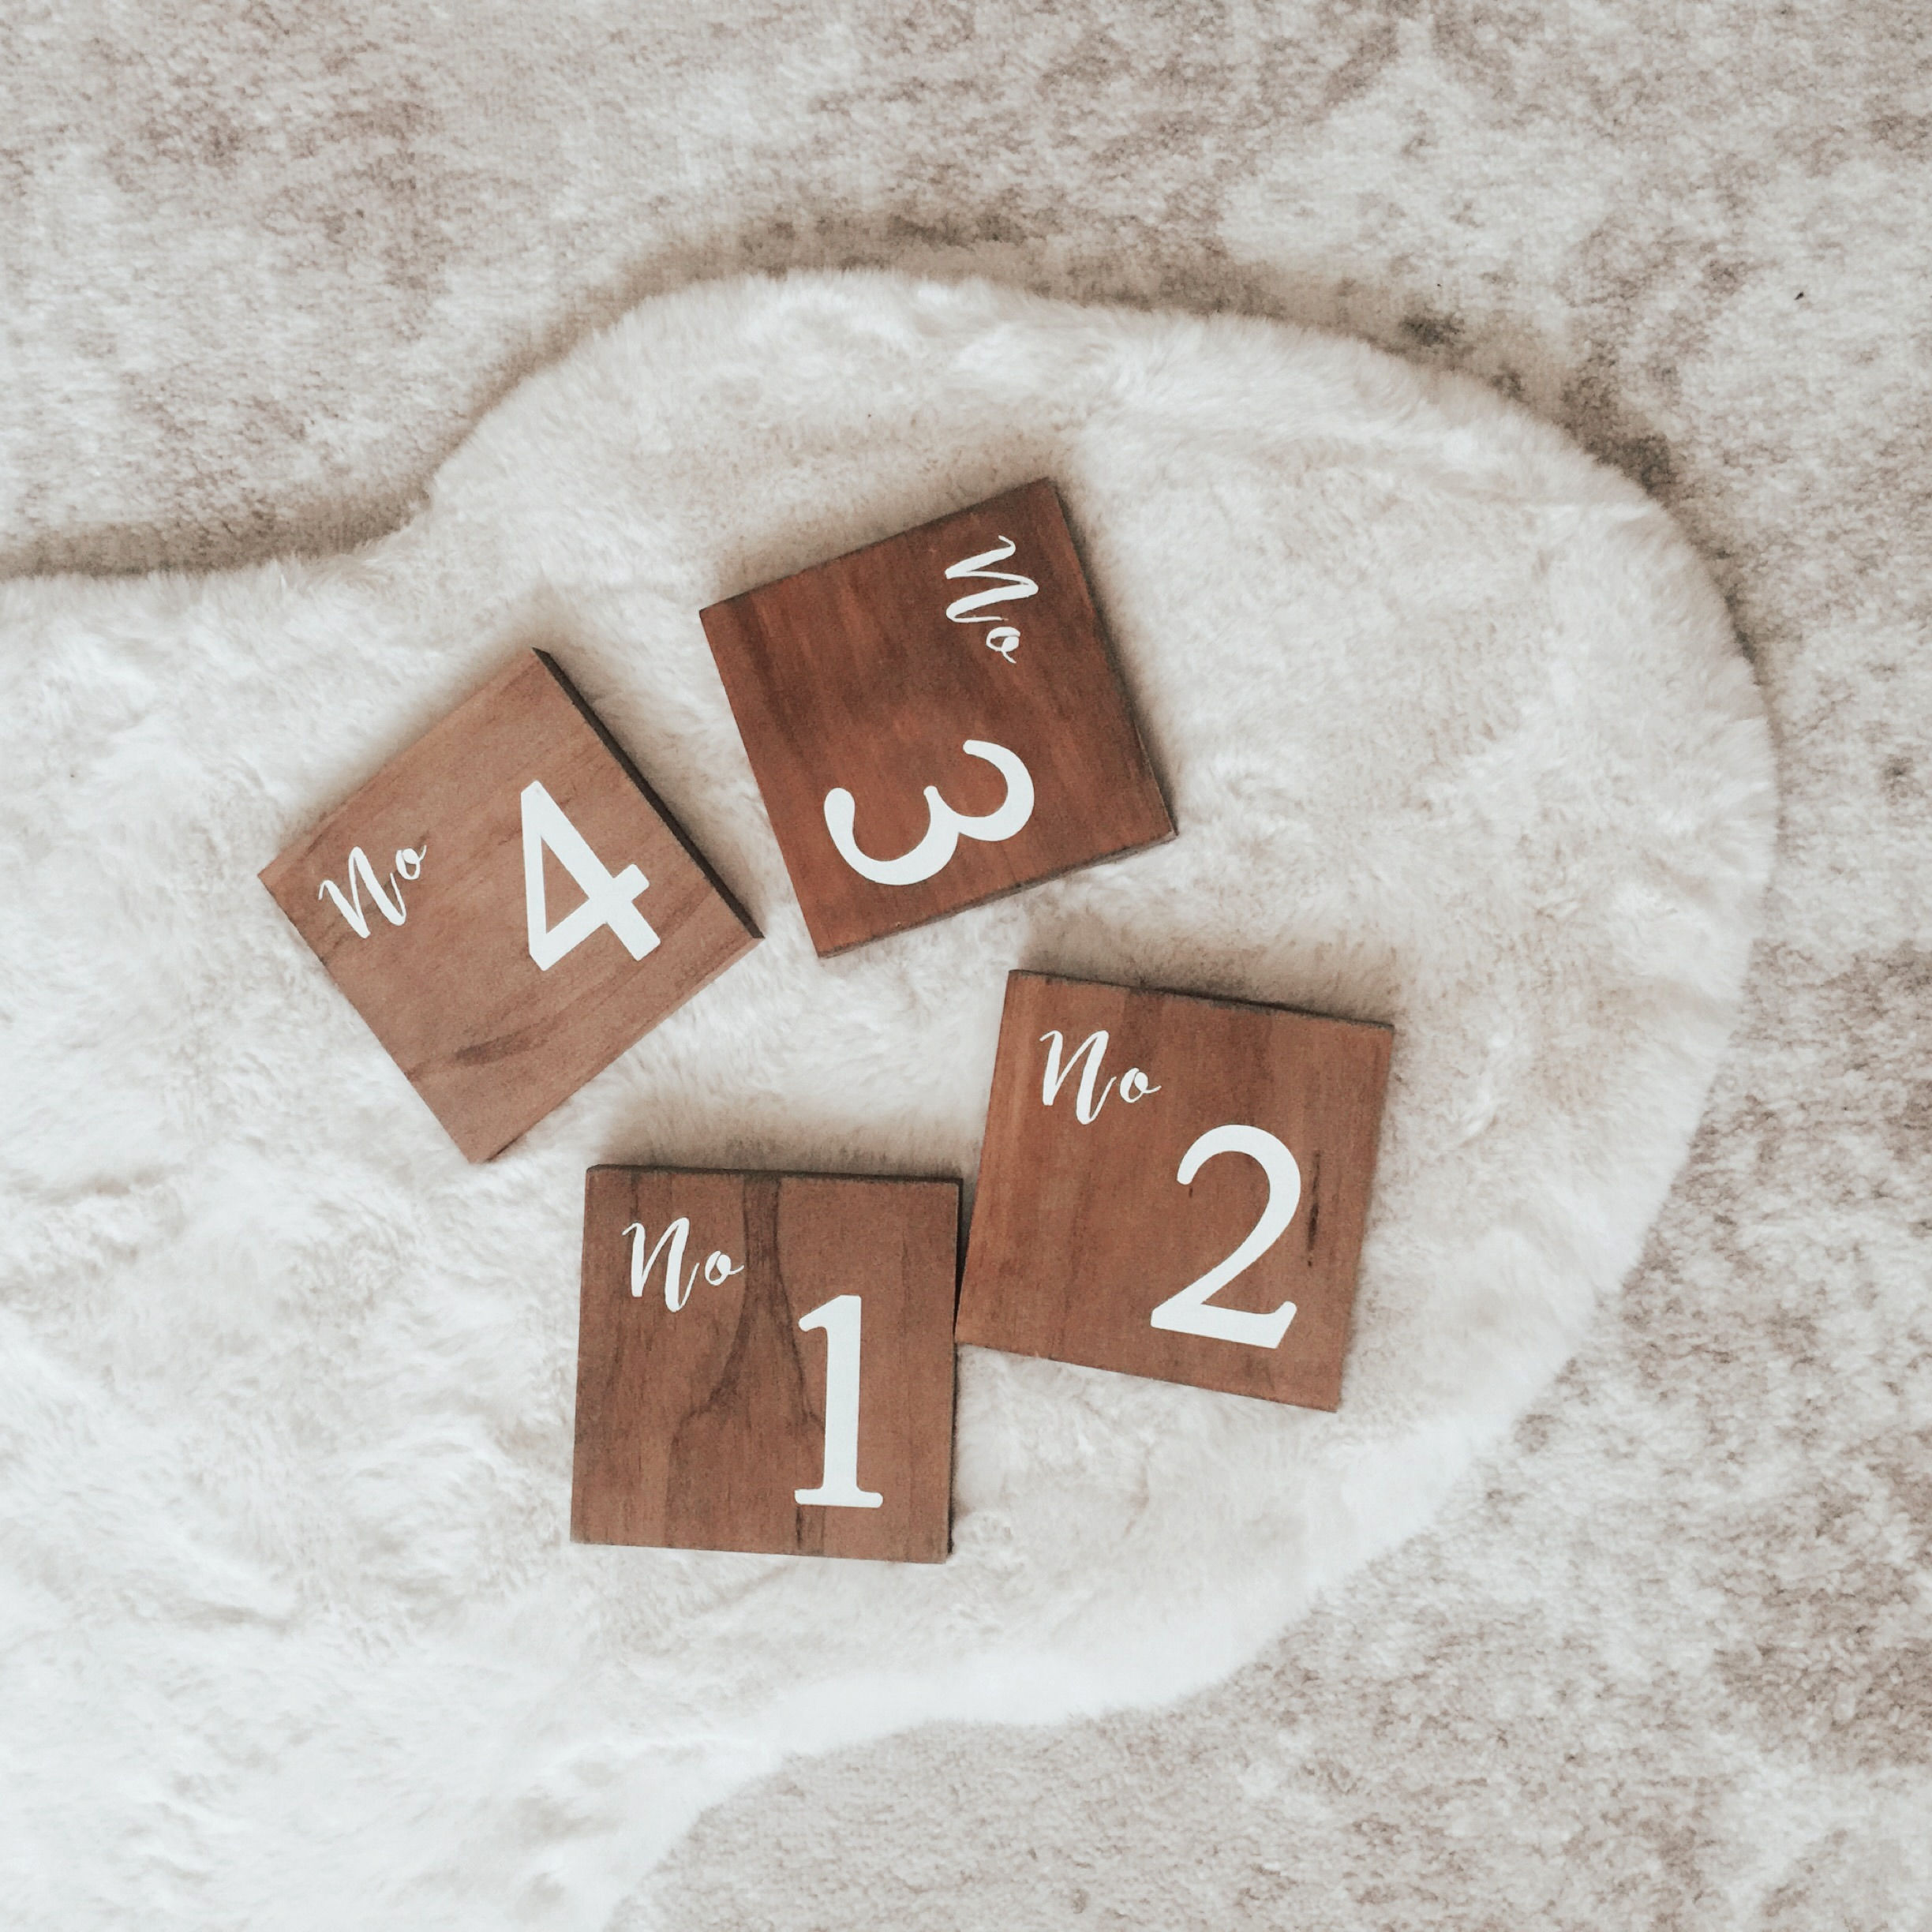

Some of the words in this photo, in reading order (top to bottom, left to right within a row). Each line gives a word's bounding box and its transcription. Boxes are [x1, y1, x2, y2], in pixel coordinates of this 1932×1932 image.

[945, 535, 1039, 664] No
[520, 779, 661, 972] 4
[823, 739, 1035, 886] 3
[317, 844, 427, 939] No
[1039, 1030, 1162, 1125] No
[622, 1217, 745, 1312] No
[1150, 1124, 1301, 1350] 2
[794, 1294, 884, 1508] 1
